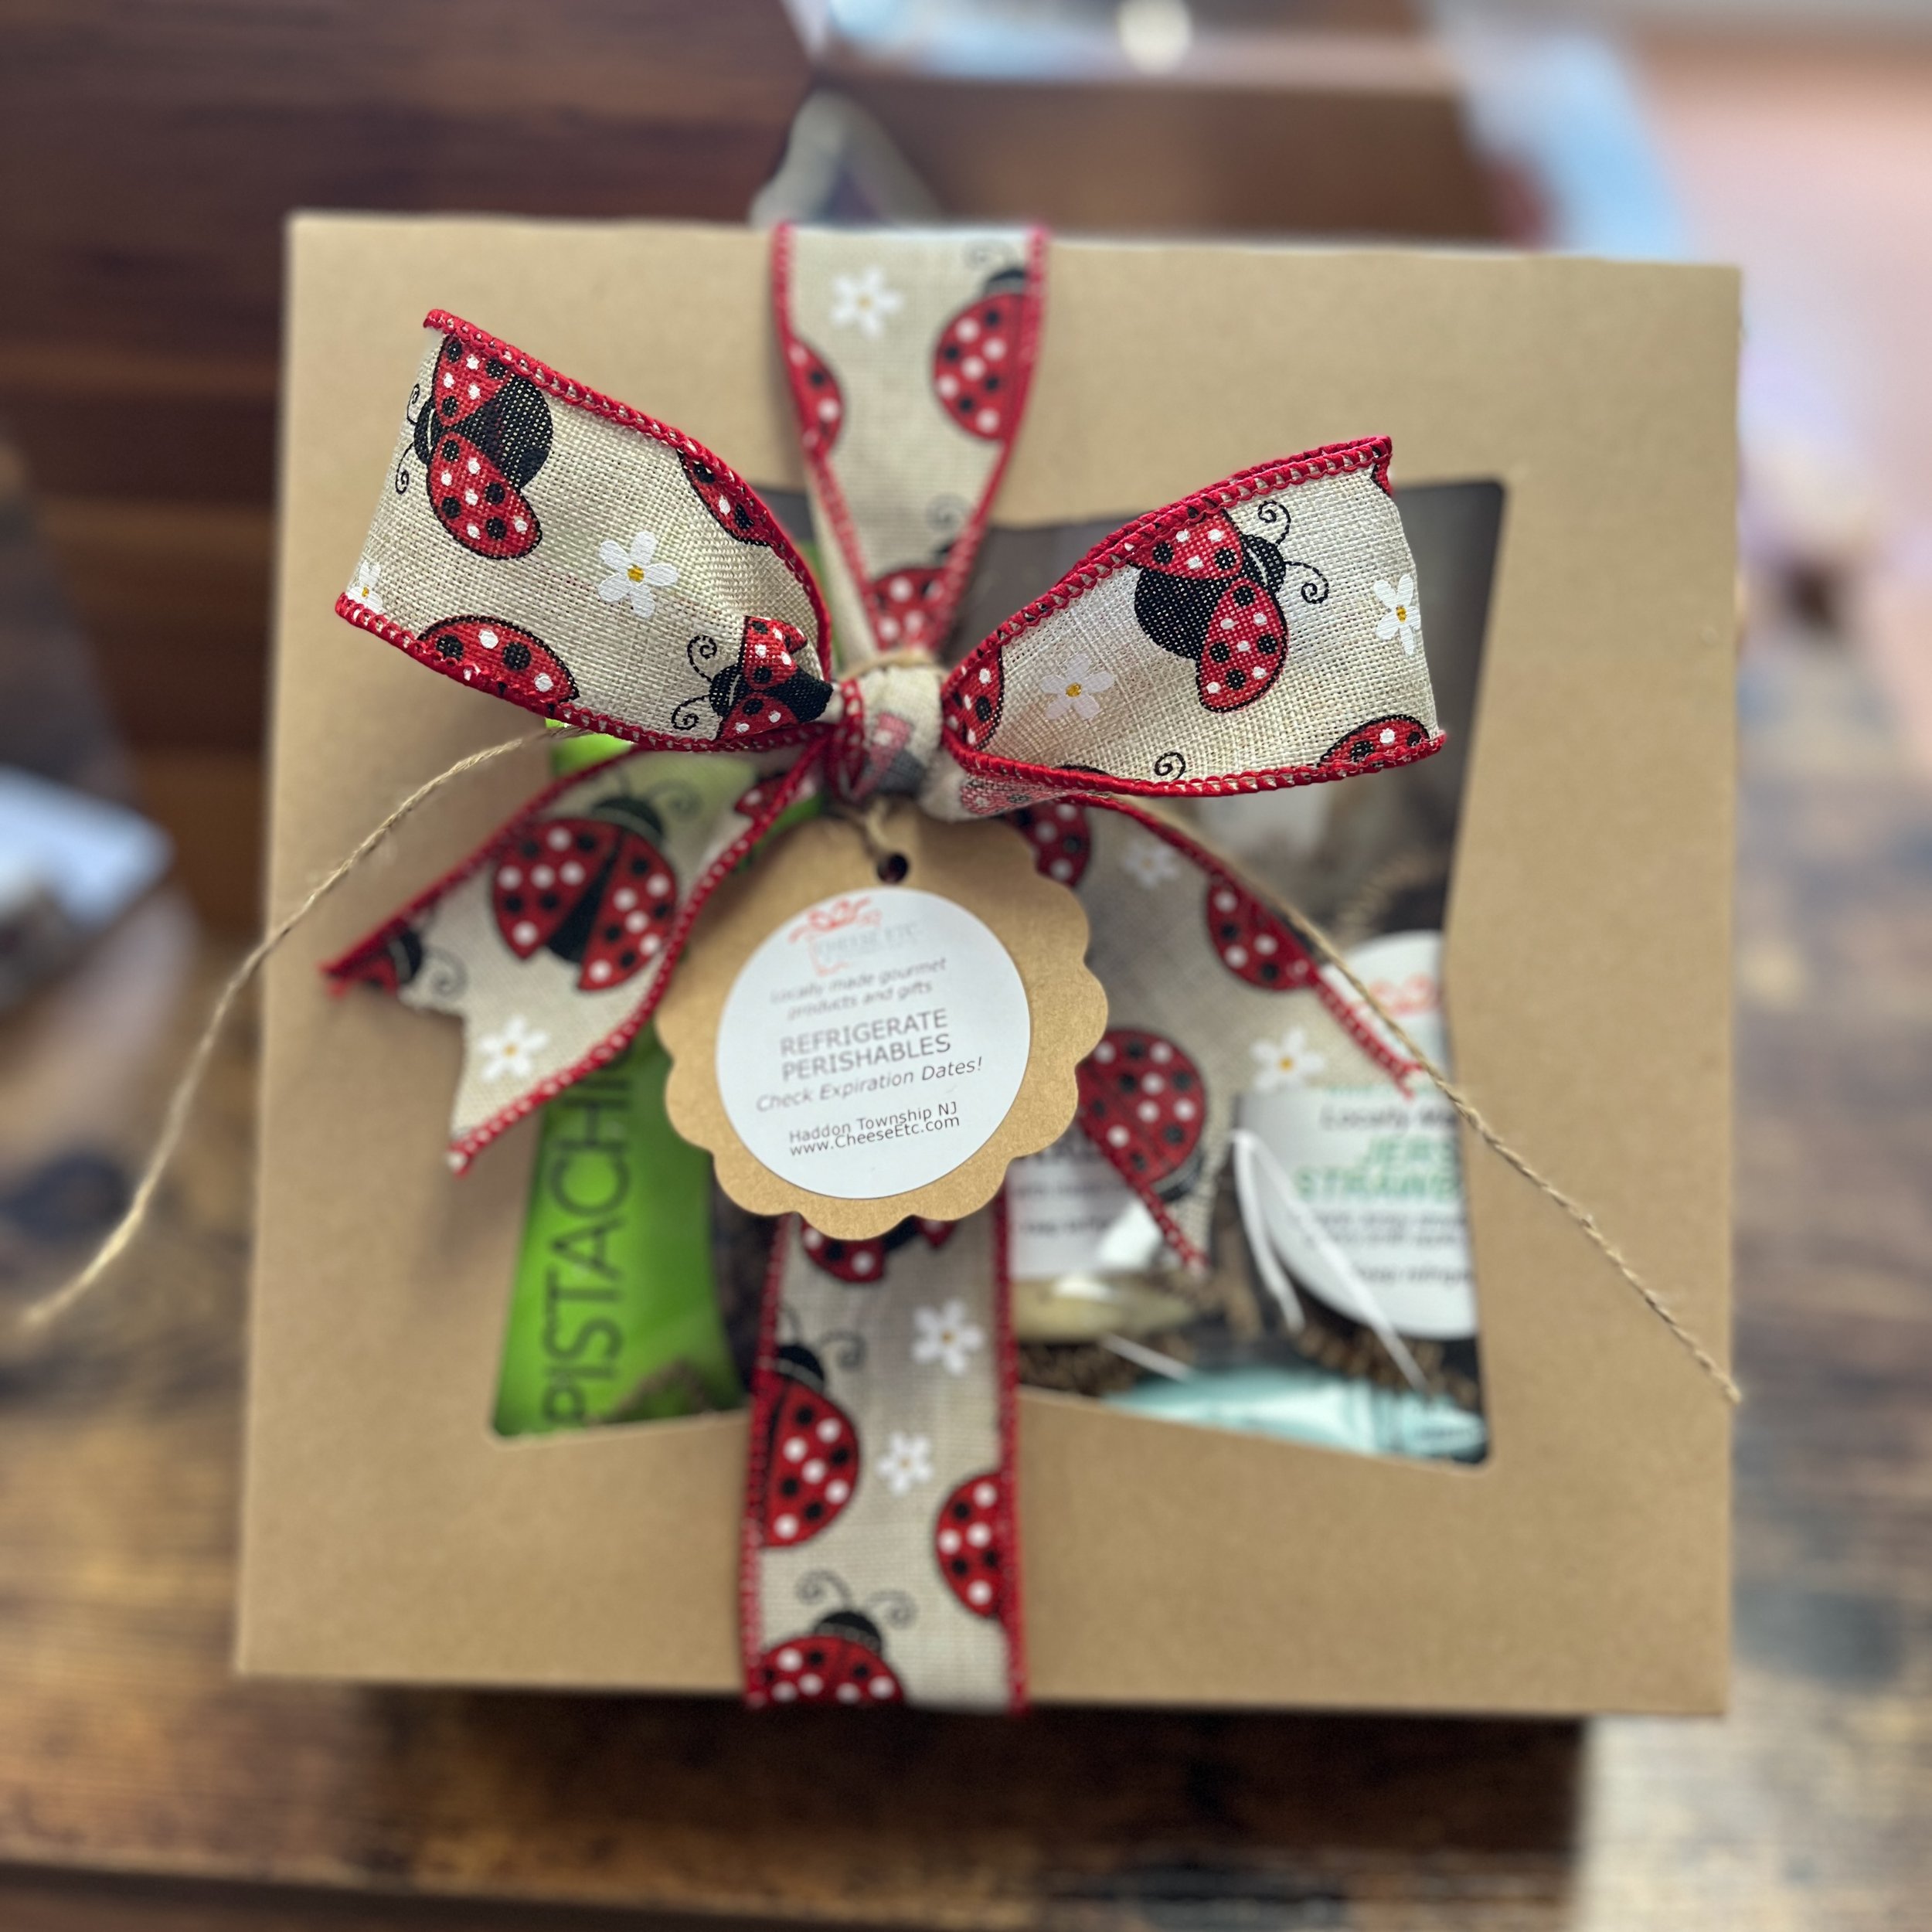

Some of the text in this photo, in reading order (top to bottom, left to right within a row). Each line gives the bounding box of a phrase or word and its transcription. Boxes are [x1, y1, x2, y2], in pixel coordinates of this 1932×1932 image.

[828, 971, 874, 992] made
[878, 957, 946, 985] gourmet
[787, 979, 933, 1021] products and gifts
[780, 1008, 948, 1058] REFRIGERATE
[782, 1033, 951, 1082] PERISHABLES
[756, 1056, 982, 1113] Check Expiration Dates!
[789, 1100, 957, 1144] Haddon Township NJ
[790, 1115, 960, 1156] www.CheeseEtc.com
[541, 1043, 634, 1427] PISTACHI
